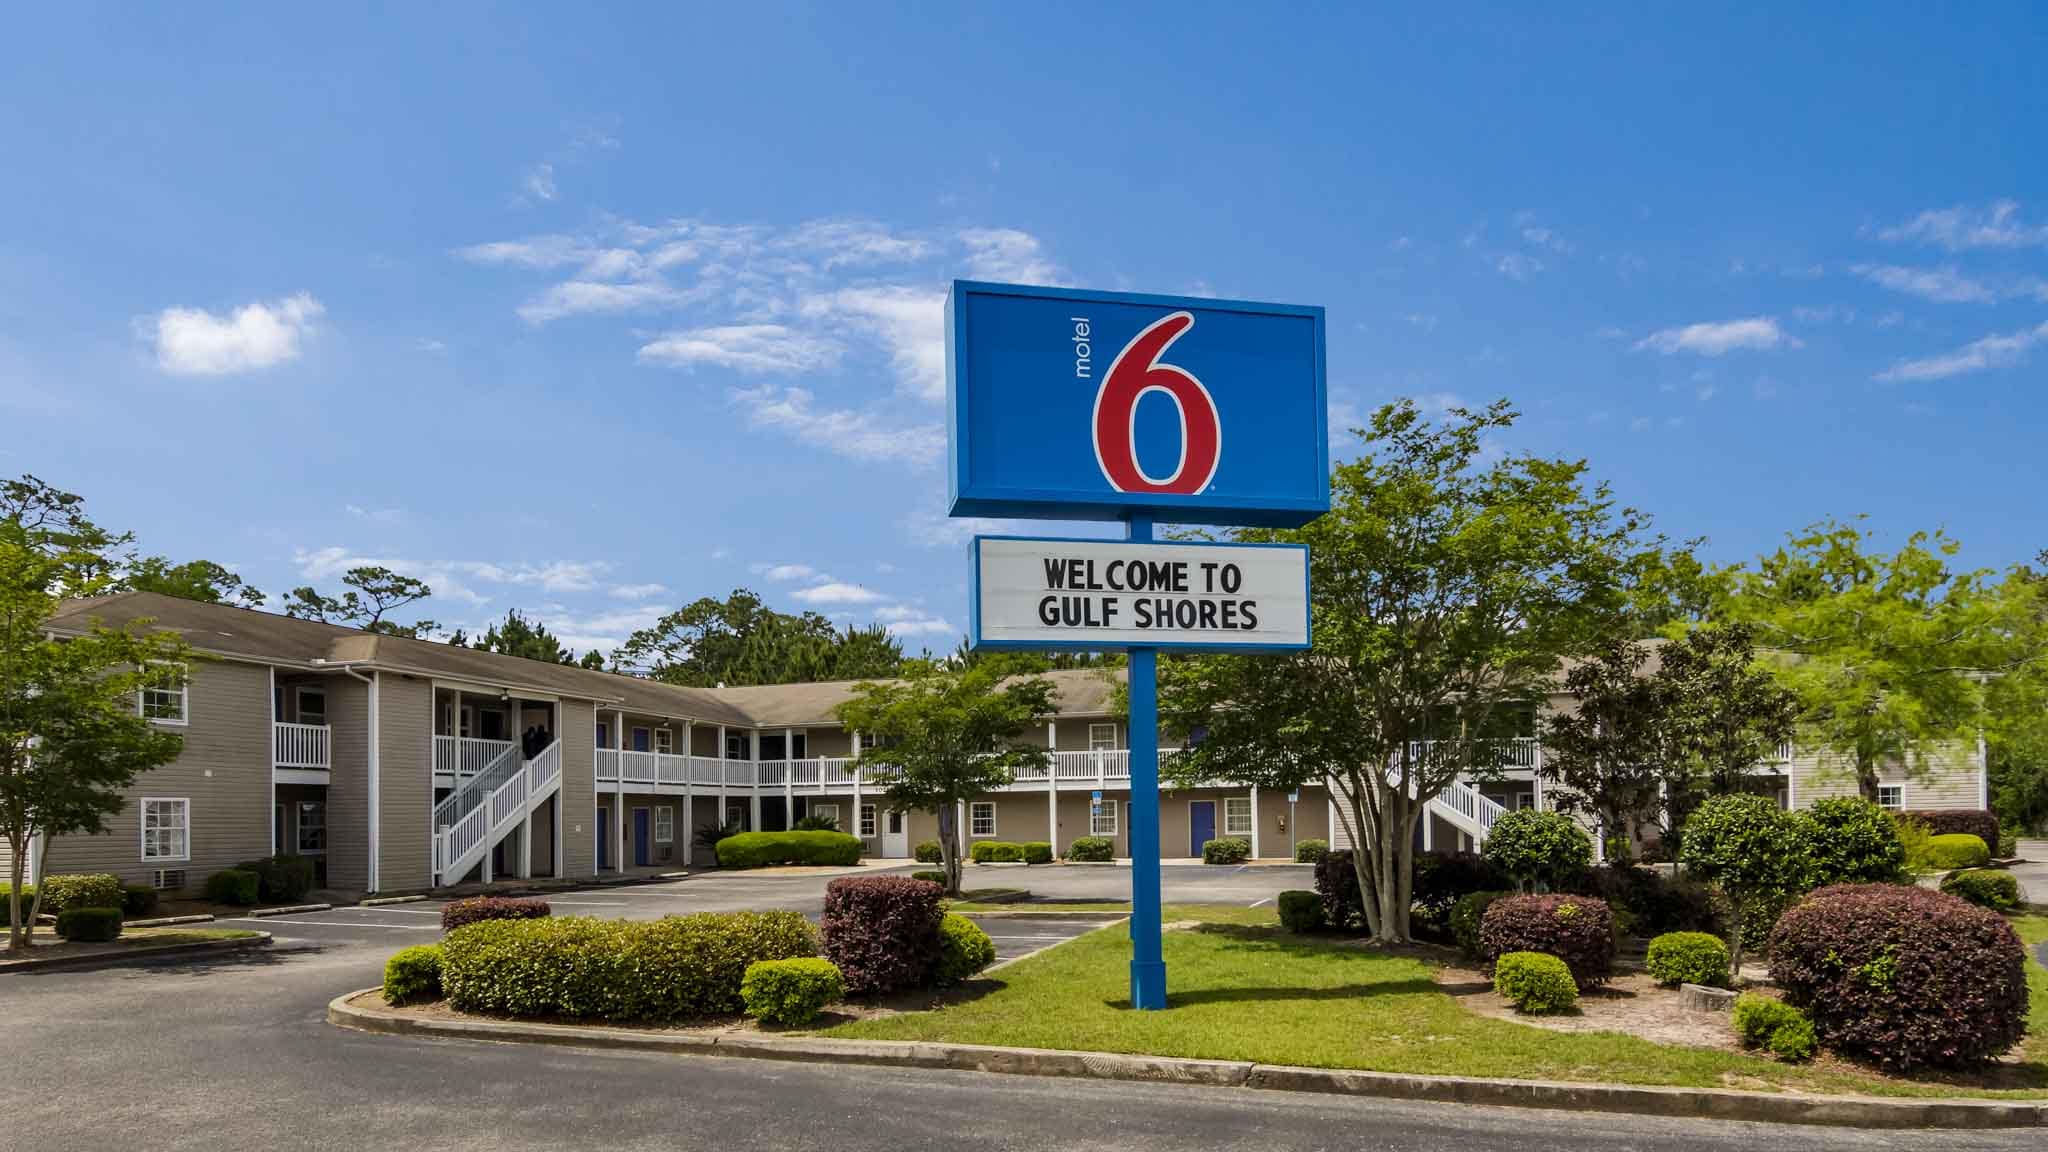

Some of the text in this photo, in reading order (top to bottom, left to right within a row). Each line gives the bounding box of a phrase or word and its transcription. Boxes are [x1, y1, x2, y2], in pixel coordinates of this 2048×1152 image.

[1072, 317, 1090, 378] motel
[1092, 310, 1221, 496] 6
[1044, 558, 1242, 594] WELCOME TO
[1038, 595, 1257, 630] GULF SHORES
